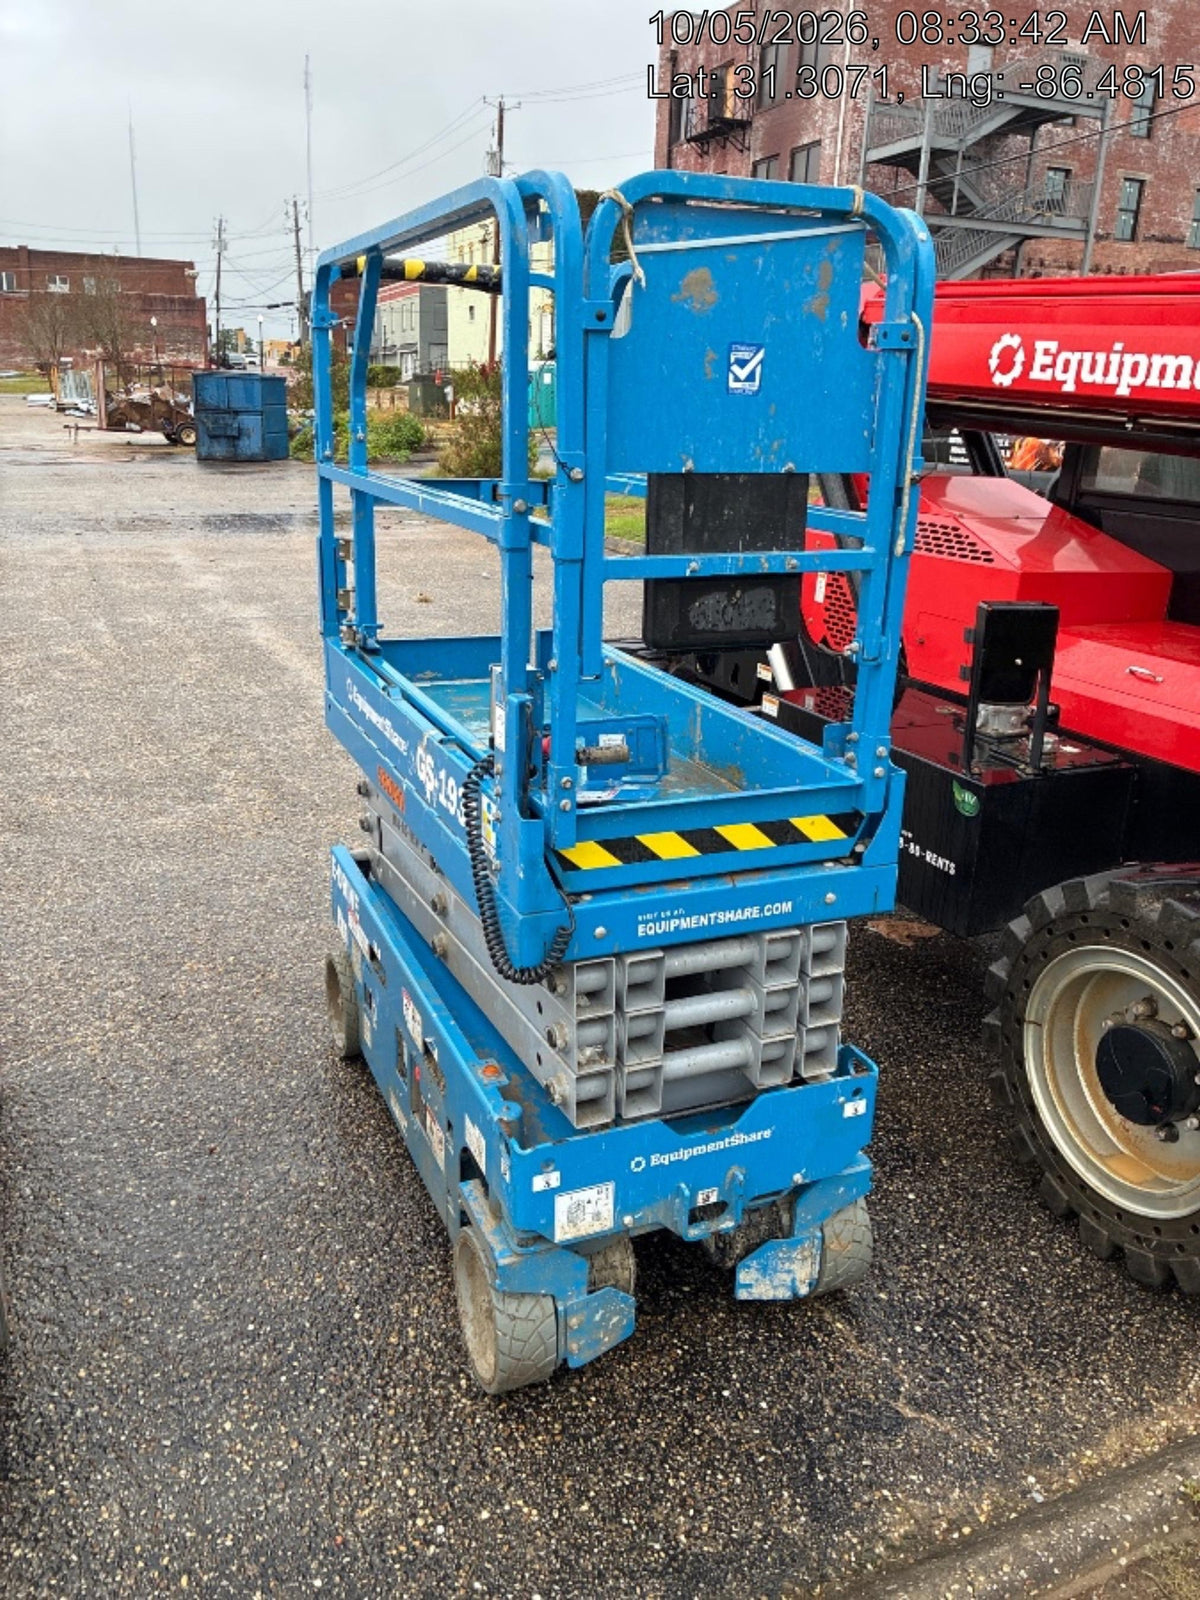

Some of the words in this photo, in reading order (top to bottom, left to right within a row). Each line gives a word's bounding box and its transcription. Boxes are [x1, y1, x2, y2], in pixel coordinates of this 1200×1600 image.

[1028, 340, 1200, 396] Equipm
[637, 900, 793, 938] EQUIPMENTSHARE.COM
[650, 1128, 772, 1168] EquipmentShare
